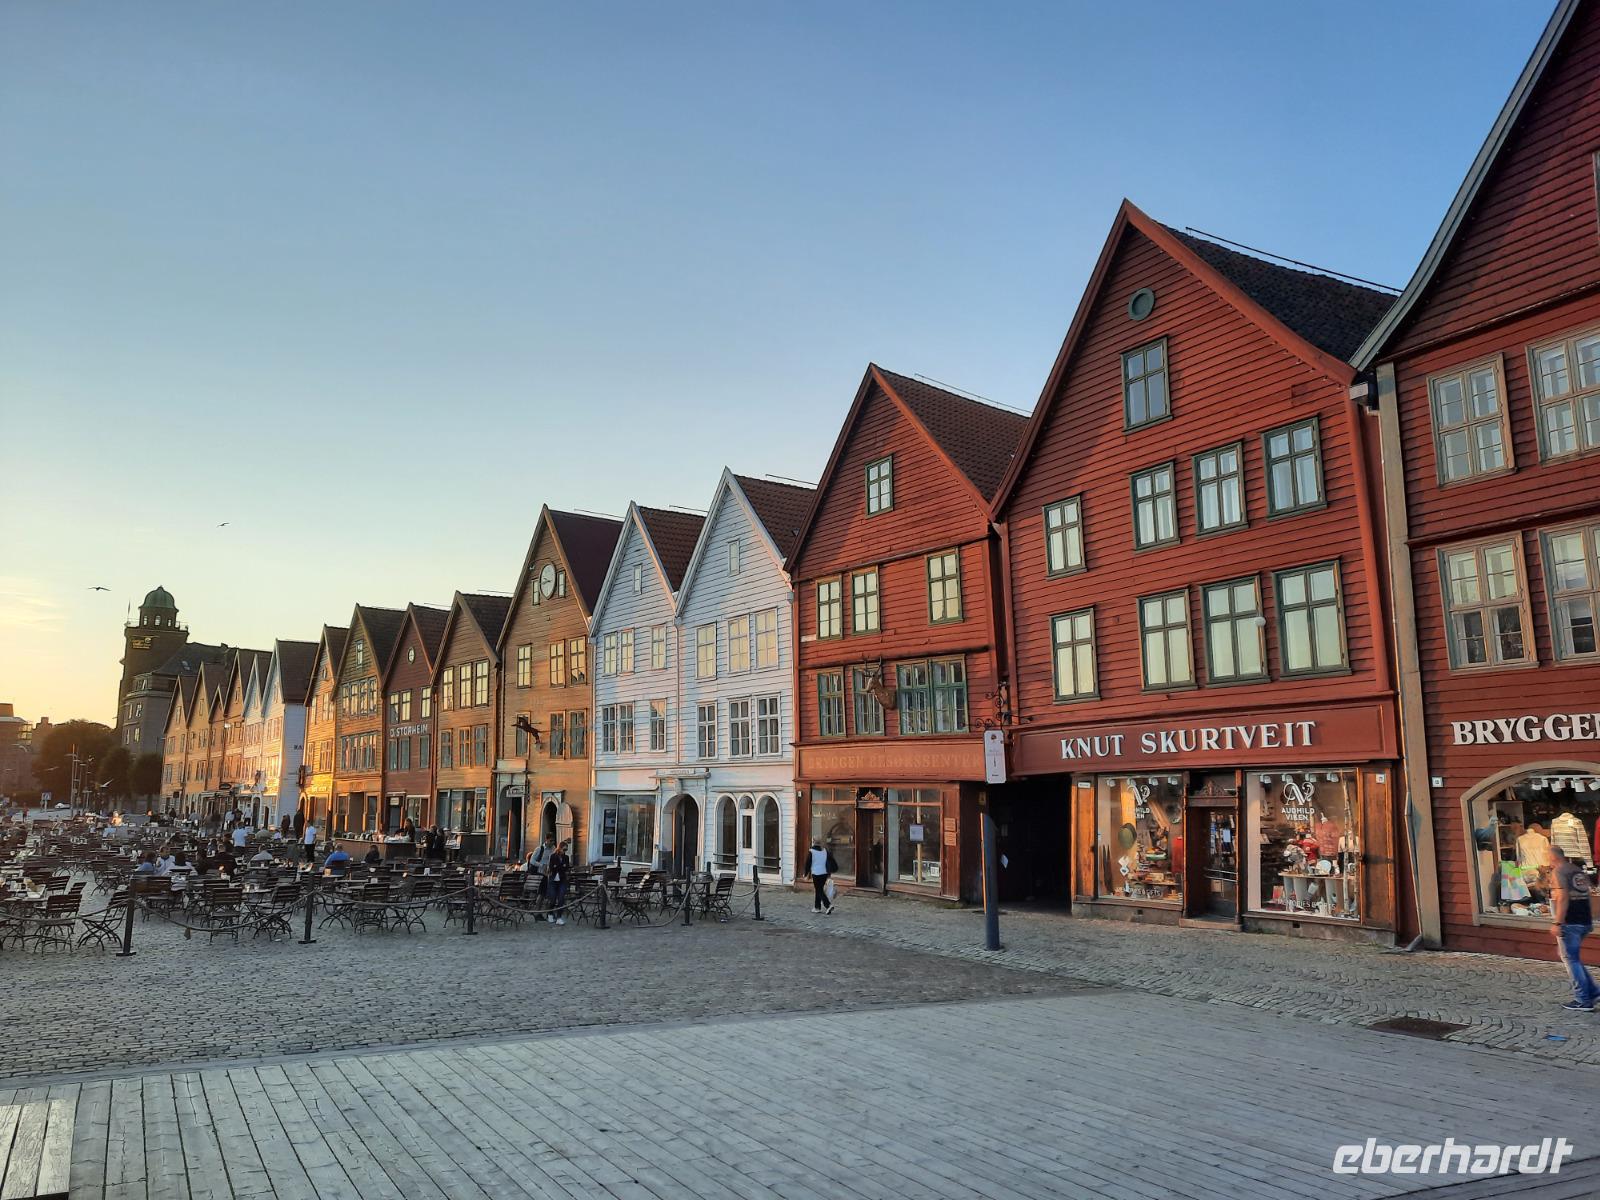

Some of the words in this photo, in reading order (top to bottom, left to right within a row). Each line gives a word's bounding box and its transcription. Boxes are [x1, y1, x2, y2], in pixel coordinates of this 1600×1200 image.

[1061, 734, 1125, 759] KNUT
[1140, 721, 1316, 755] SKURTVEIT
[1451, 713, 1600, 746] BRYGGE
